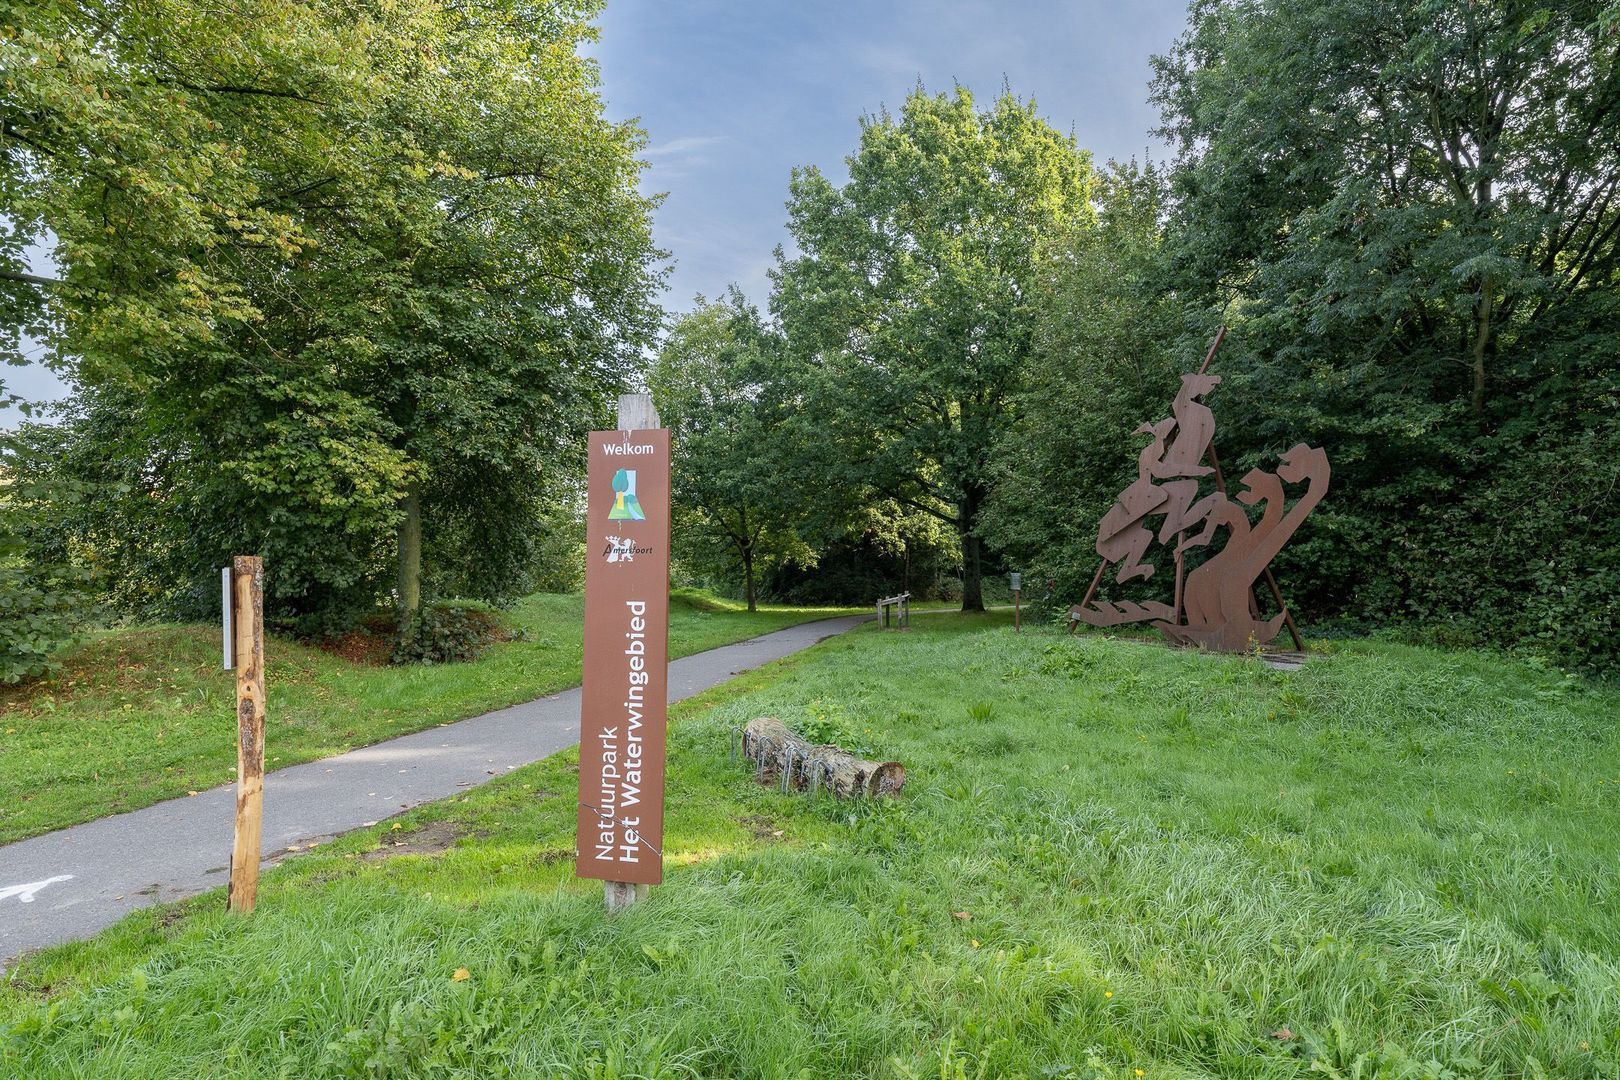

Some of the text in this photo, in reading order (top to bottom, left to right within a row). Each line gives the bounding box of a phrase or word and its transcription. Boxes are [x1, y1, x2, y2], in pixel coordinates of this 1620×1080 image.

[603, 443, 654, 456] Welkom
[602, 543, 653, 557] Amersfoort
[620, 600, 648, 863] Het Waterwingebied
[595, 726, 618, 861] Natuurpark
